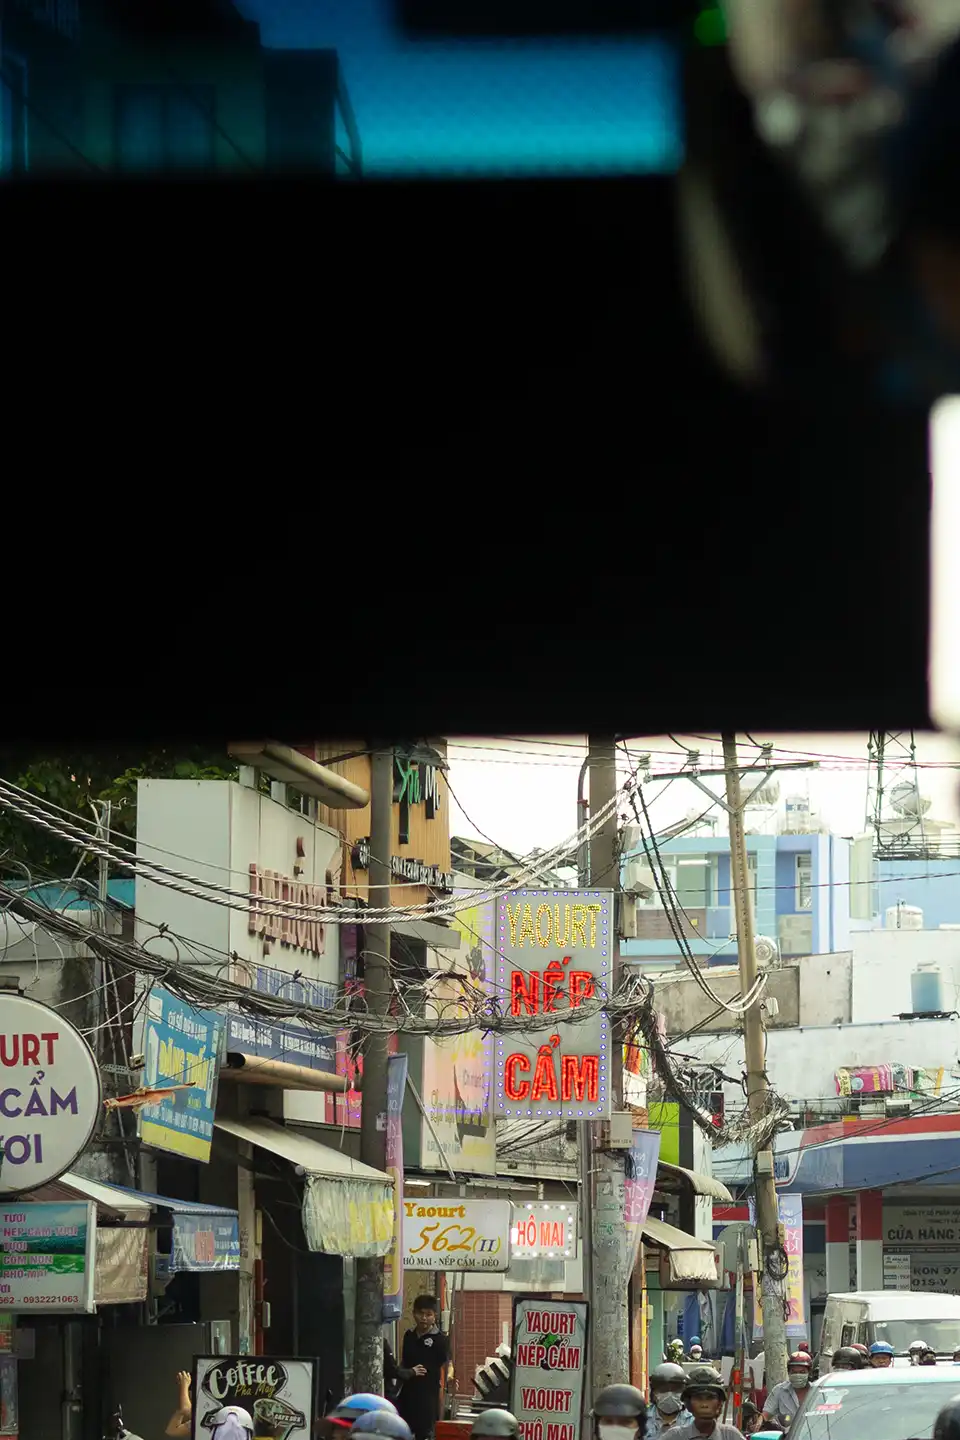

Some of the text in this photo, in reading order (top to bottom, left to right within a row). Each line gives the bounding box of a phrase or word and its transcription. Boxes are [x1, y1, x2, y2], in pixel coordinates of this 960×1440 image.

[506, 903, 601, 947] YAOURT
[511, 956, 595, 1016] NẾP
[505, 1035, 599, 1102] CẨM
[0, 1070, 78, 1118] CẨM
[404, 1202, 466, 1218] Yaourt
[540, 1222, 564, 1247] MAI
[888, 1224, 913, 1240] CỬA
[919, 1227, 954, 1240] HÀNG
[526, 1311, 577, 1336] YAOURT
[517, 1337, 581, 1369] NẾP CẨM
[521, 1386, 573, 1413] YAOURT
